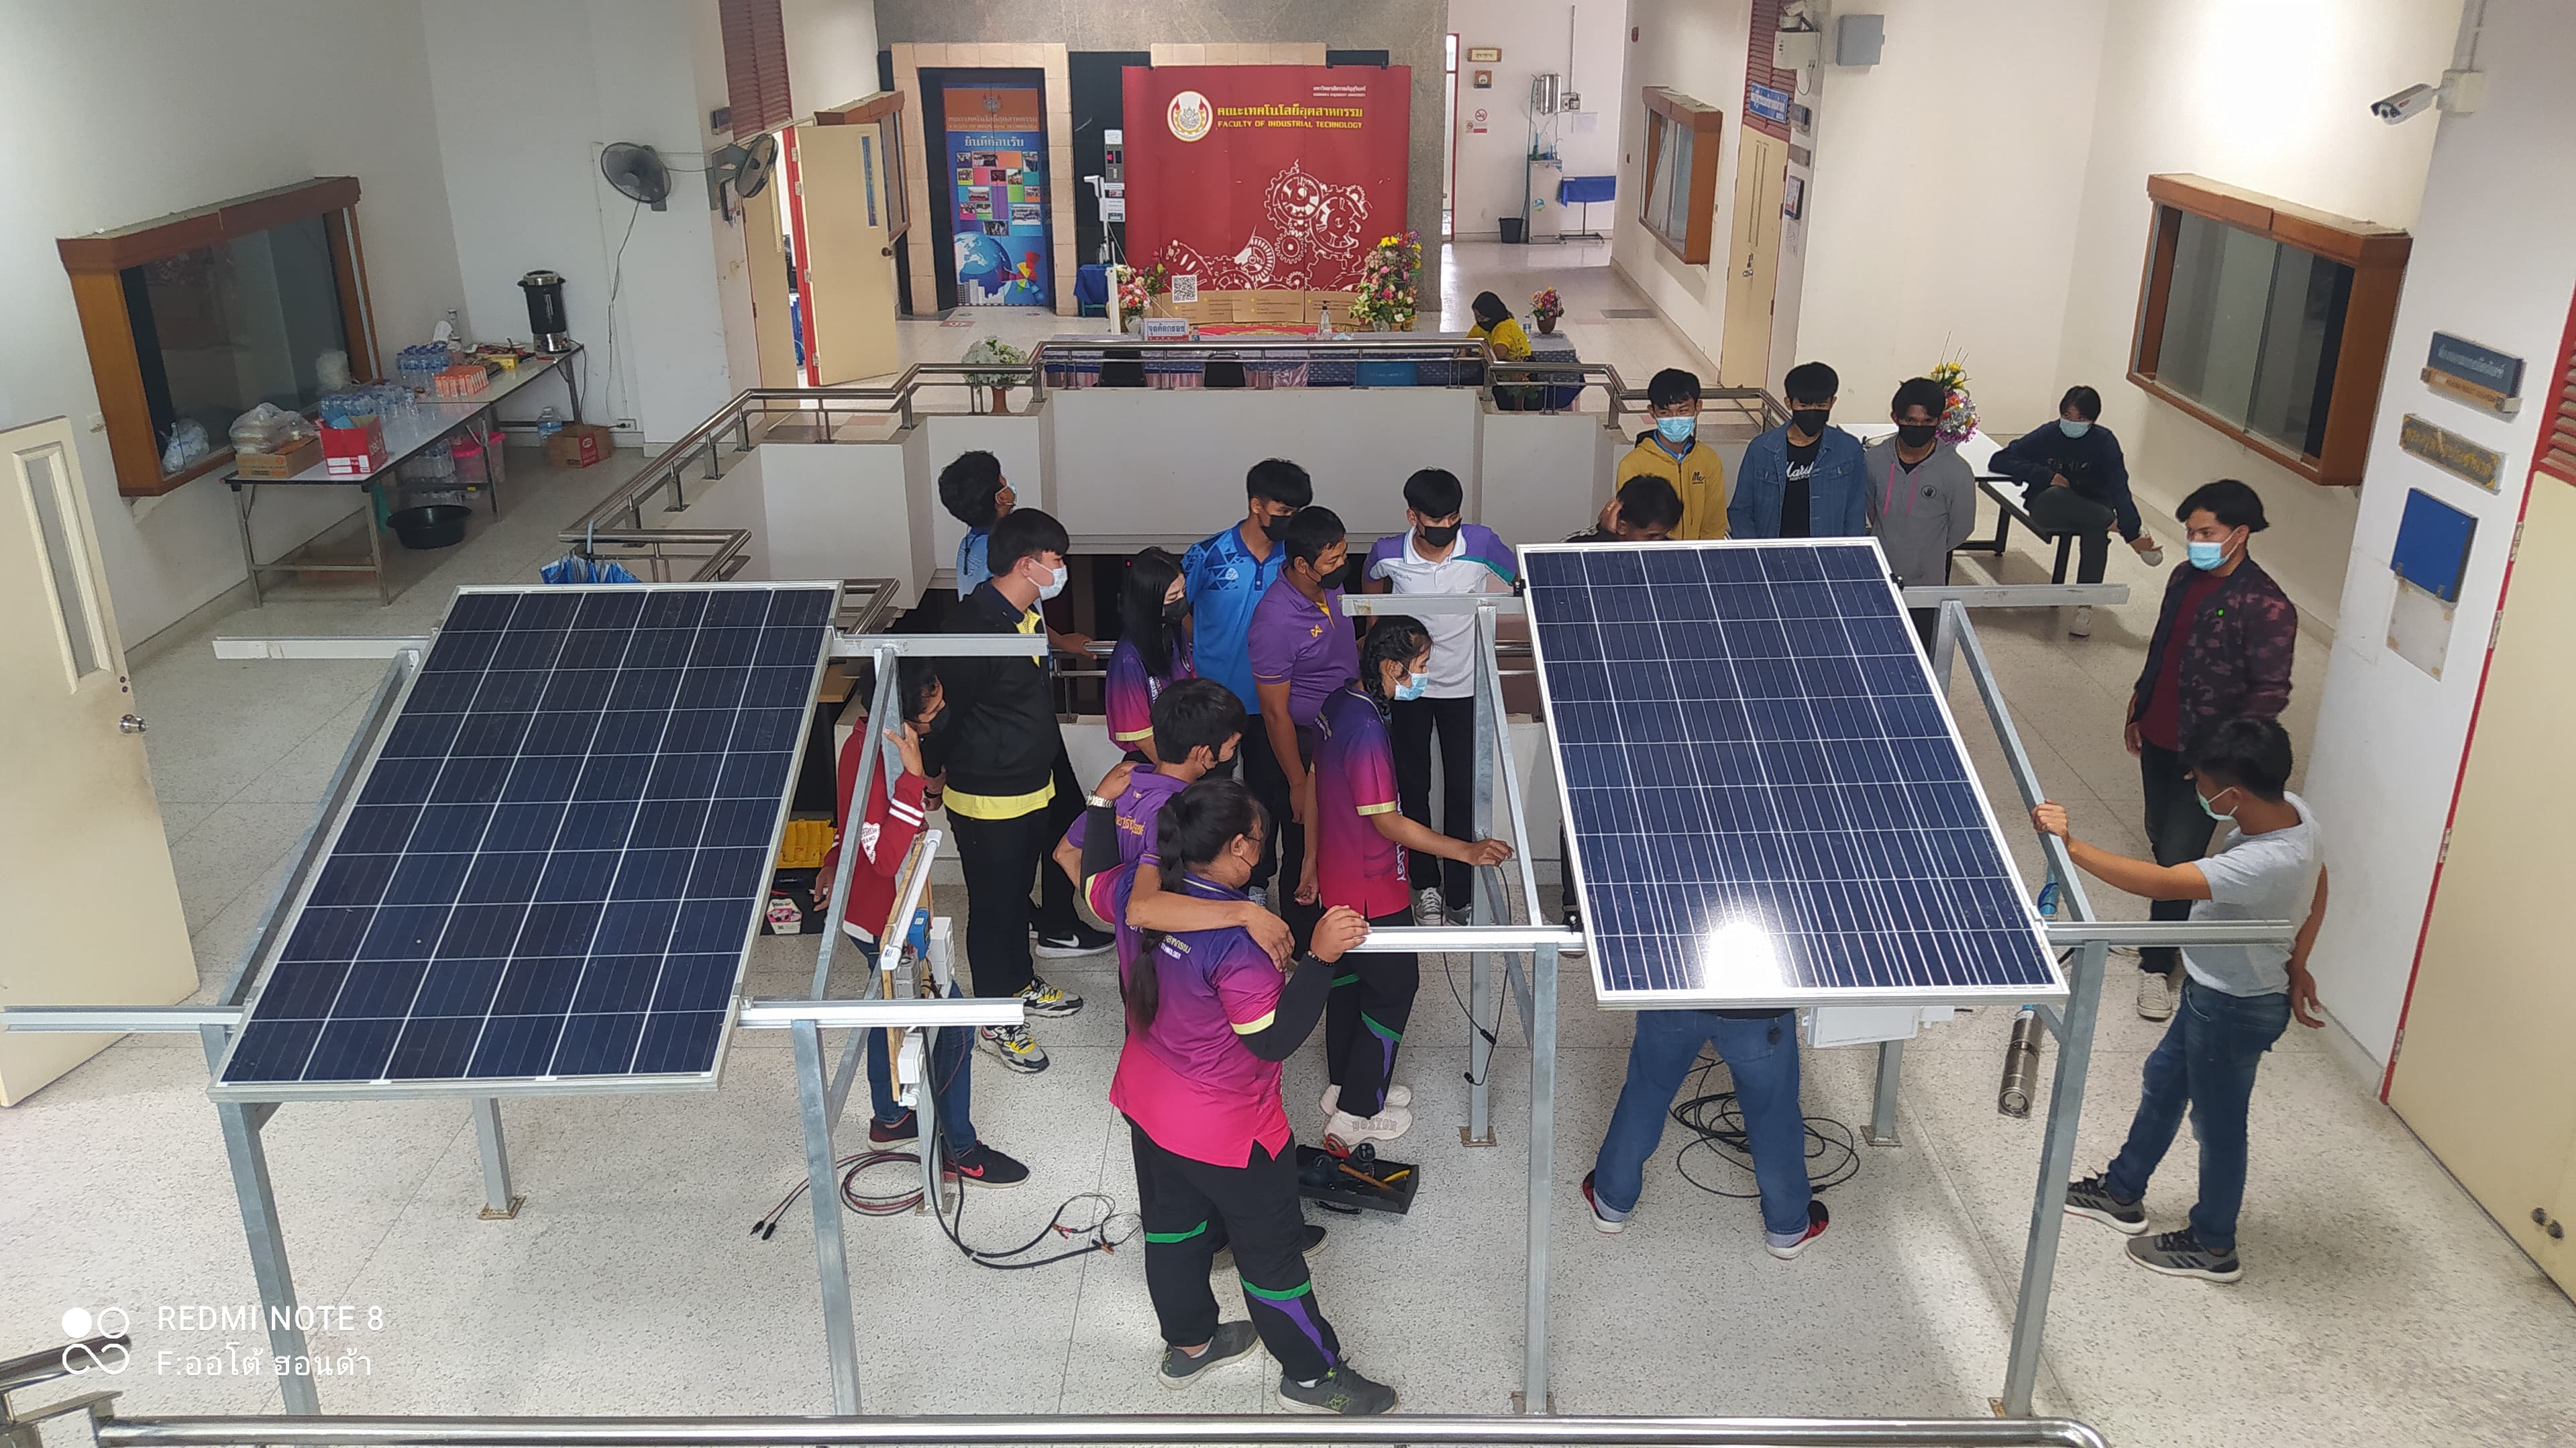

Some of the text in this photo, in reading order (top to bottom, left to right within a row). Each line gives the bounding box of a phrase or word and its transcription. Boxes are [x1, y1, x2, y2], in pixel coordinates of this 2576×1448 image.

[1217, 103, 1363, 119] คณะเทคโนโลยีอุตสาหกรรม
[1268, 120, 1313, 128] INDUSTRIAL
[1316, 121, 1362, 129] TECHNOLOGY
